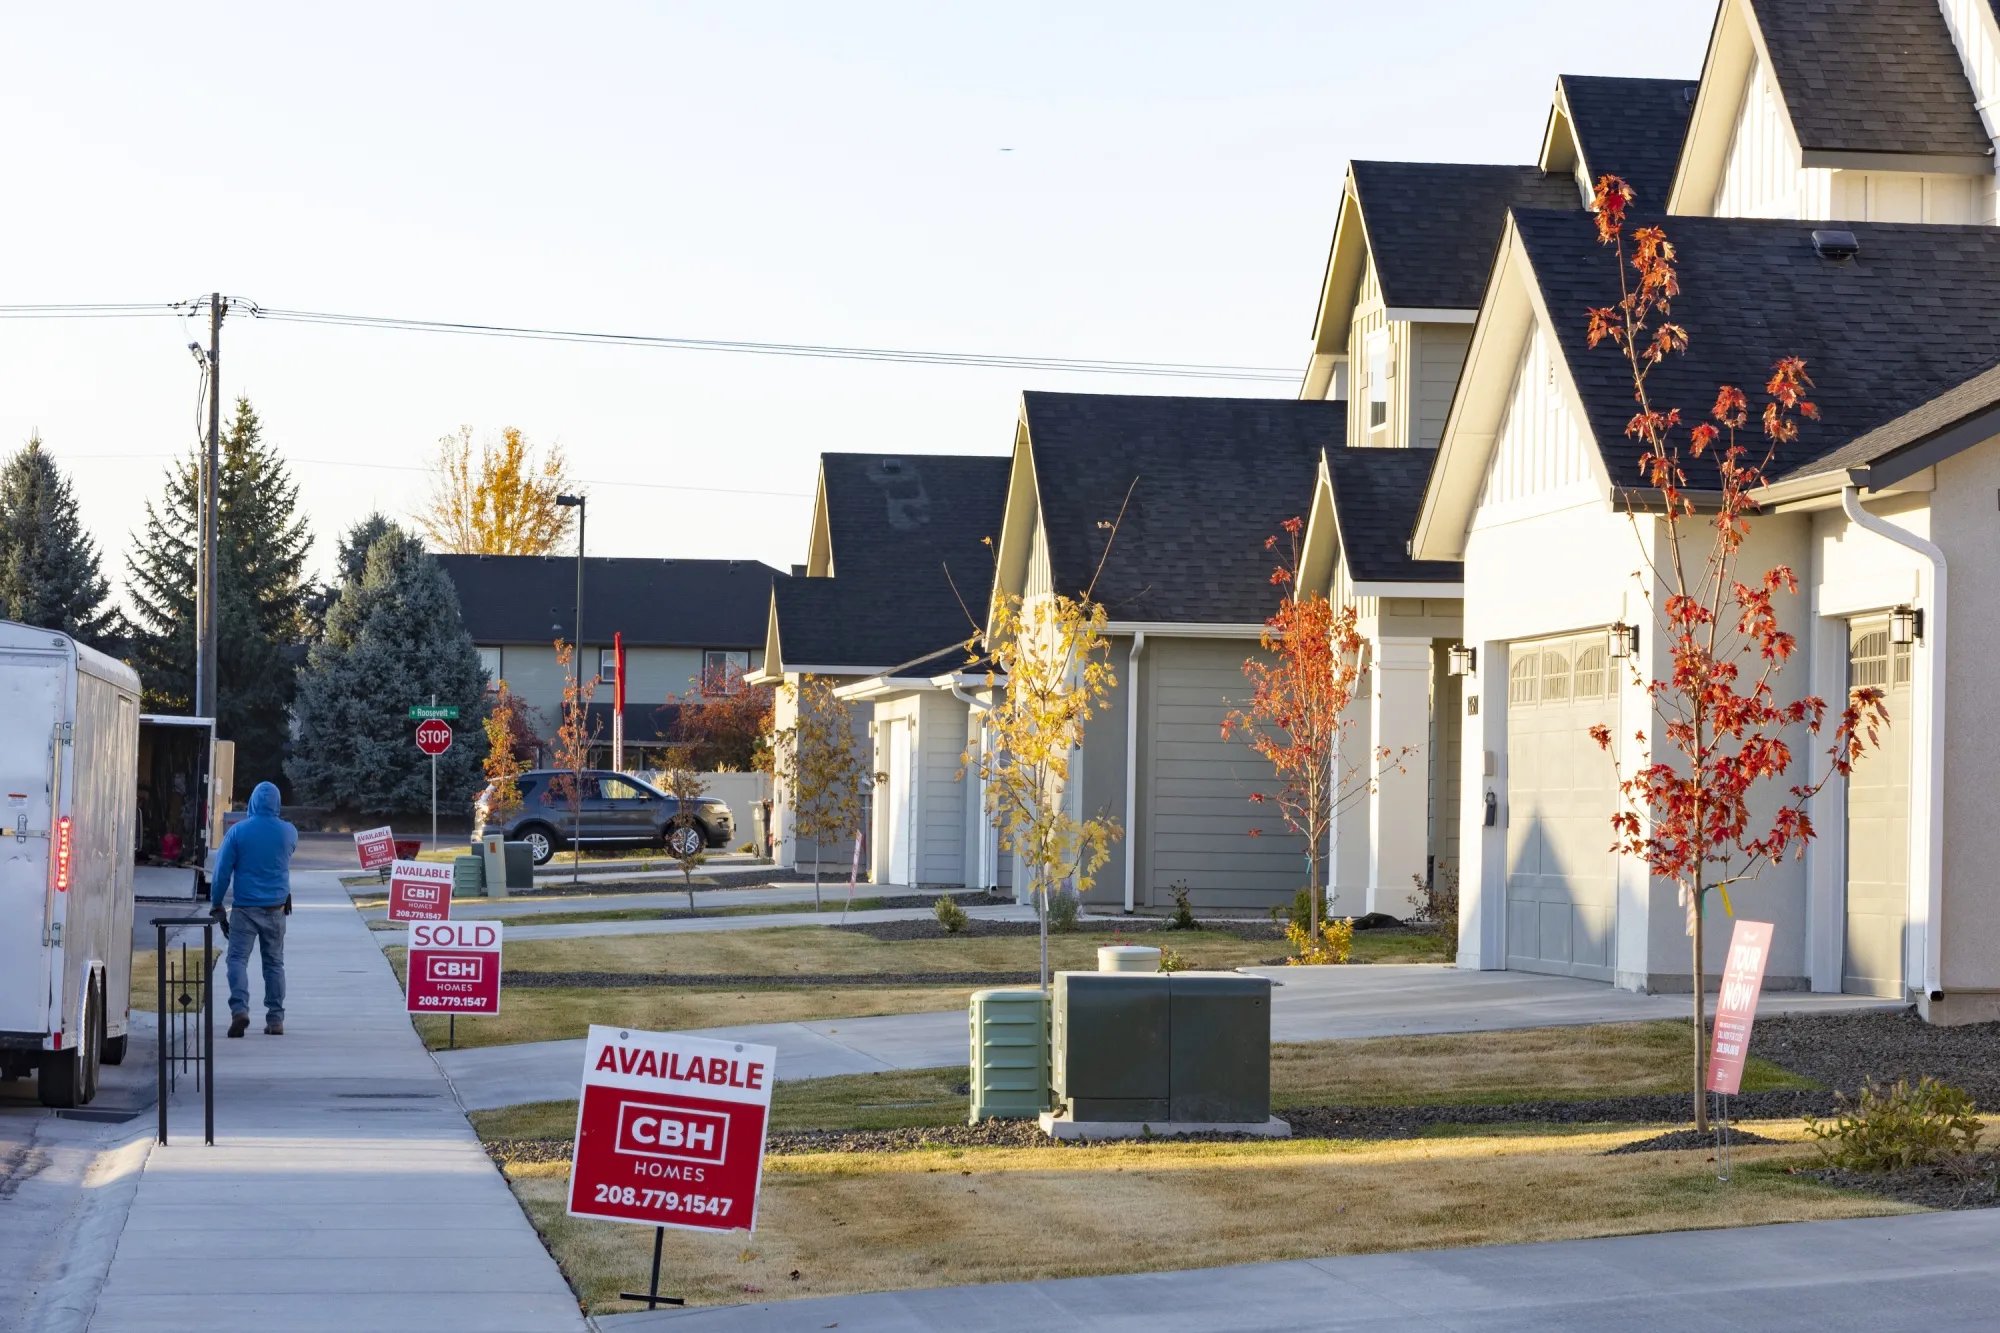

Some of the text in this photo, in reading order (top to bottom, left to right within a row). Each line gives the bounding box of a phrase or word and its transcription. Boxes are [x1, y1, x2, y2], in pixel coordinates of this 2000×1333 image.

[417, 708, 448, 717] Roosevelt
[419, 730, 449, 744] STOP
[357, 829, 390, 842] AVAILABLE
[368, 844, 385, 853] CBH
[395, 865, 451, 879] AVAILABLE
[407, 888, 435, 899] CBH
[408, 902, 433, 910] HOMES
[396, 909, 442, 920] 208.779.1547
[414, 925, 496, 947] SOLD
[1732, 945, 1762, 973] TOUR
[433, 962, 476, 977] CBH
[437, 983, 473, 992] HOMES
[418, 995, 488, 1007] 208.779.1547
[1722, 981, 1754, 1012] NOW
[595, 1045, 765, 1091] AVAILABLE
[631, 1116, 715, 1151] CBH
[634, 1161, 705, 1182] HOMES
[594, 1183, 733, 1217] 208.779.1547
